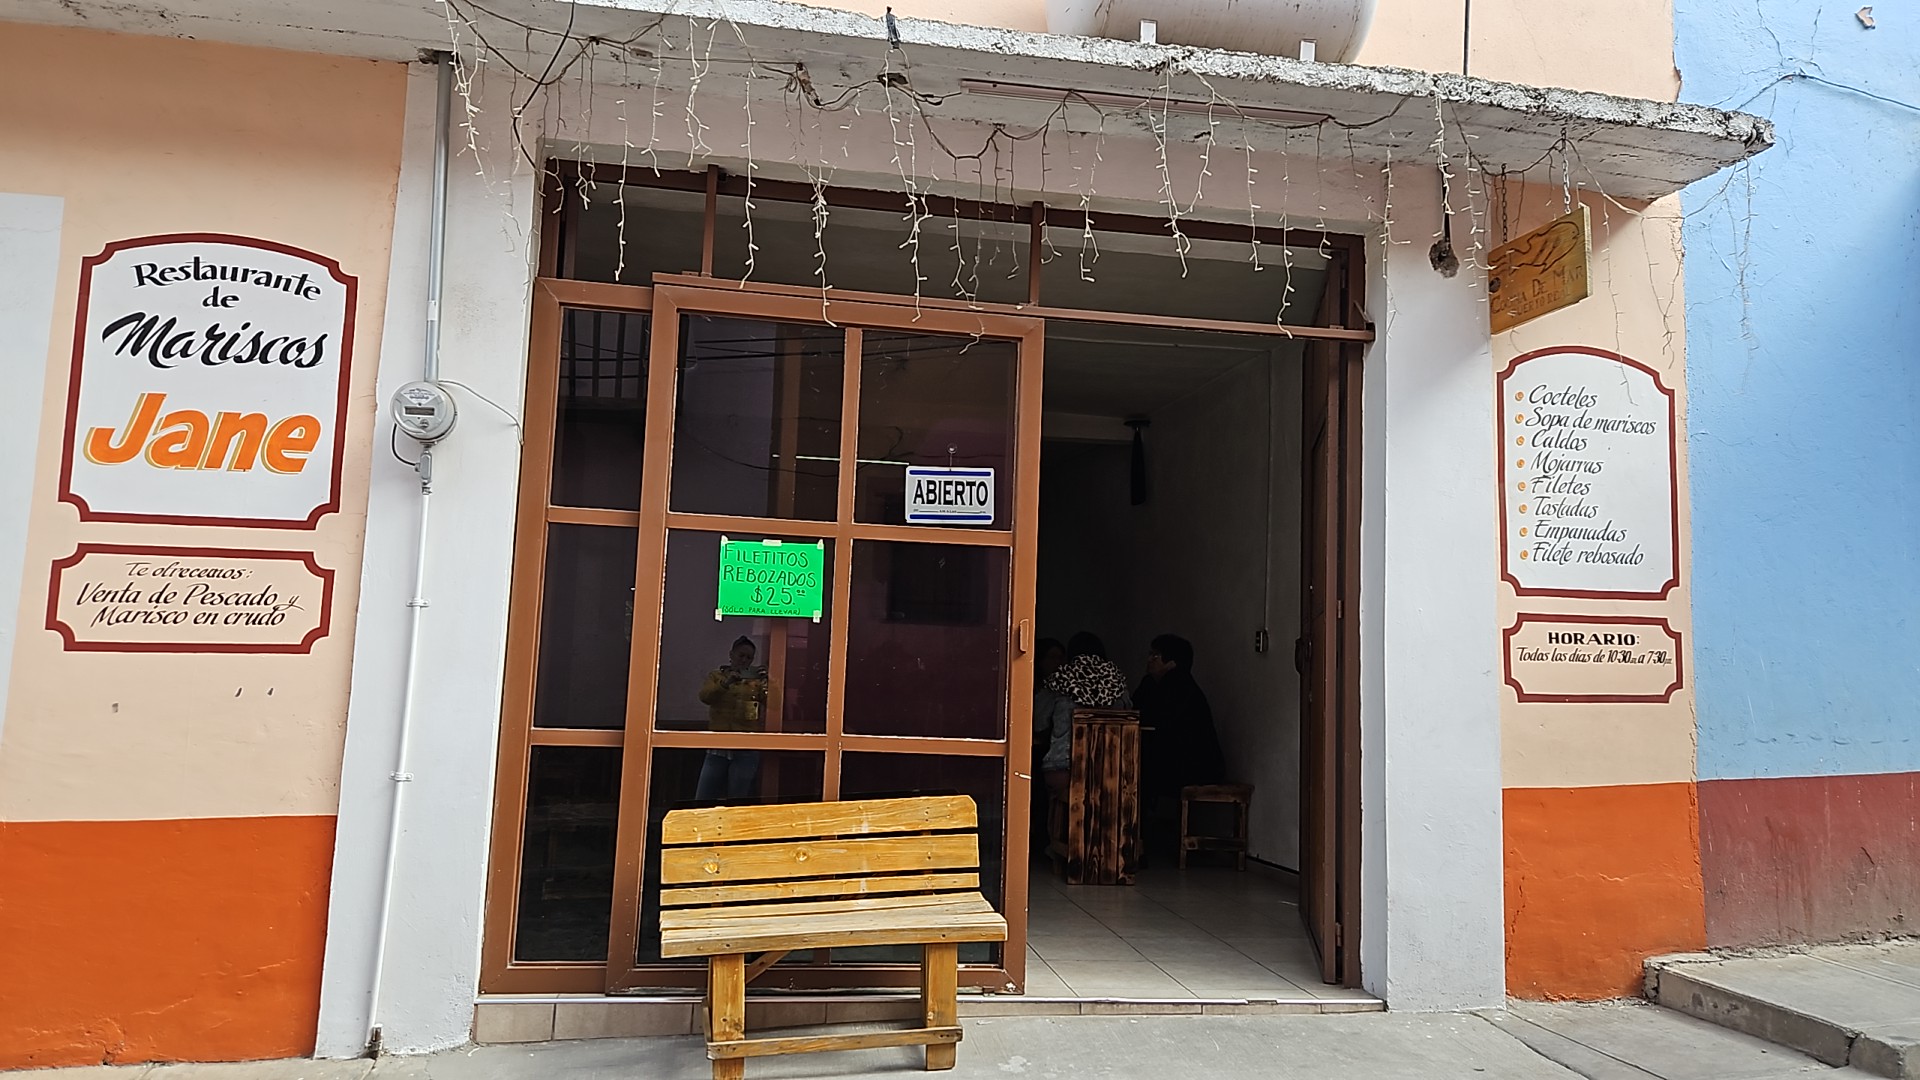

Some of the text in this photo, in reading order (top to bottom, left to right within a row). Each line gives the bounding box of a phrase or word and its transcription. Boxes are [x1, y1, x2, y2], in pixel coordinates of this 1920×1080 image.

[131, 256, 321, 300] Restaurante
[202, 286, 239, 308] de
[102, 311, 328, 369] Mariscos
[1528, 384, 1598, 409] Cocteles
[1525, 406, 1657, 434] Sopa de mariscos
[83, 392, 321, 475] Jane
[1531, 429, 1588, 451] Caldos
[1530, 450, 1604, 477] Mojarras
[913, 479, 988, 507] ABIERTO
[1529, 474, 1592, 496] Filetes
[1533, 495, 1599, 519] Tostadas
[1534, 519, 1628, 543] Empanadas
[724, 542, 809, 568] FILETITOS
[1532, 541, 1644, 566] Filete rebosado
[126, 561, 254, 580] Te ofrecemos:
[723, 564, 817, 588] REBOZADOS
[76, 581, 305, 612] Venta de Pescado y
[90, 605, 286, 629] Marisco en crudo
[748, 606, 766, 614] PARA
[770, 607, 801, 616] LLEVAR)
[1548, 631, 1641, 646] HORARIO:
[1516, 646, 1550, 662] Todas
[1593, 648, 1606, 663] de
[1638, 654, 1645, 664] a
